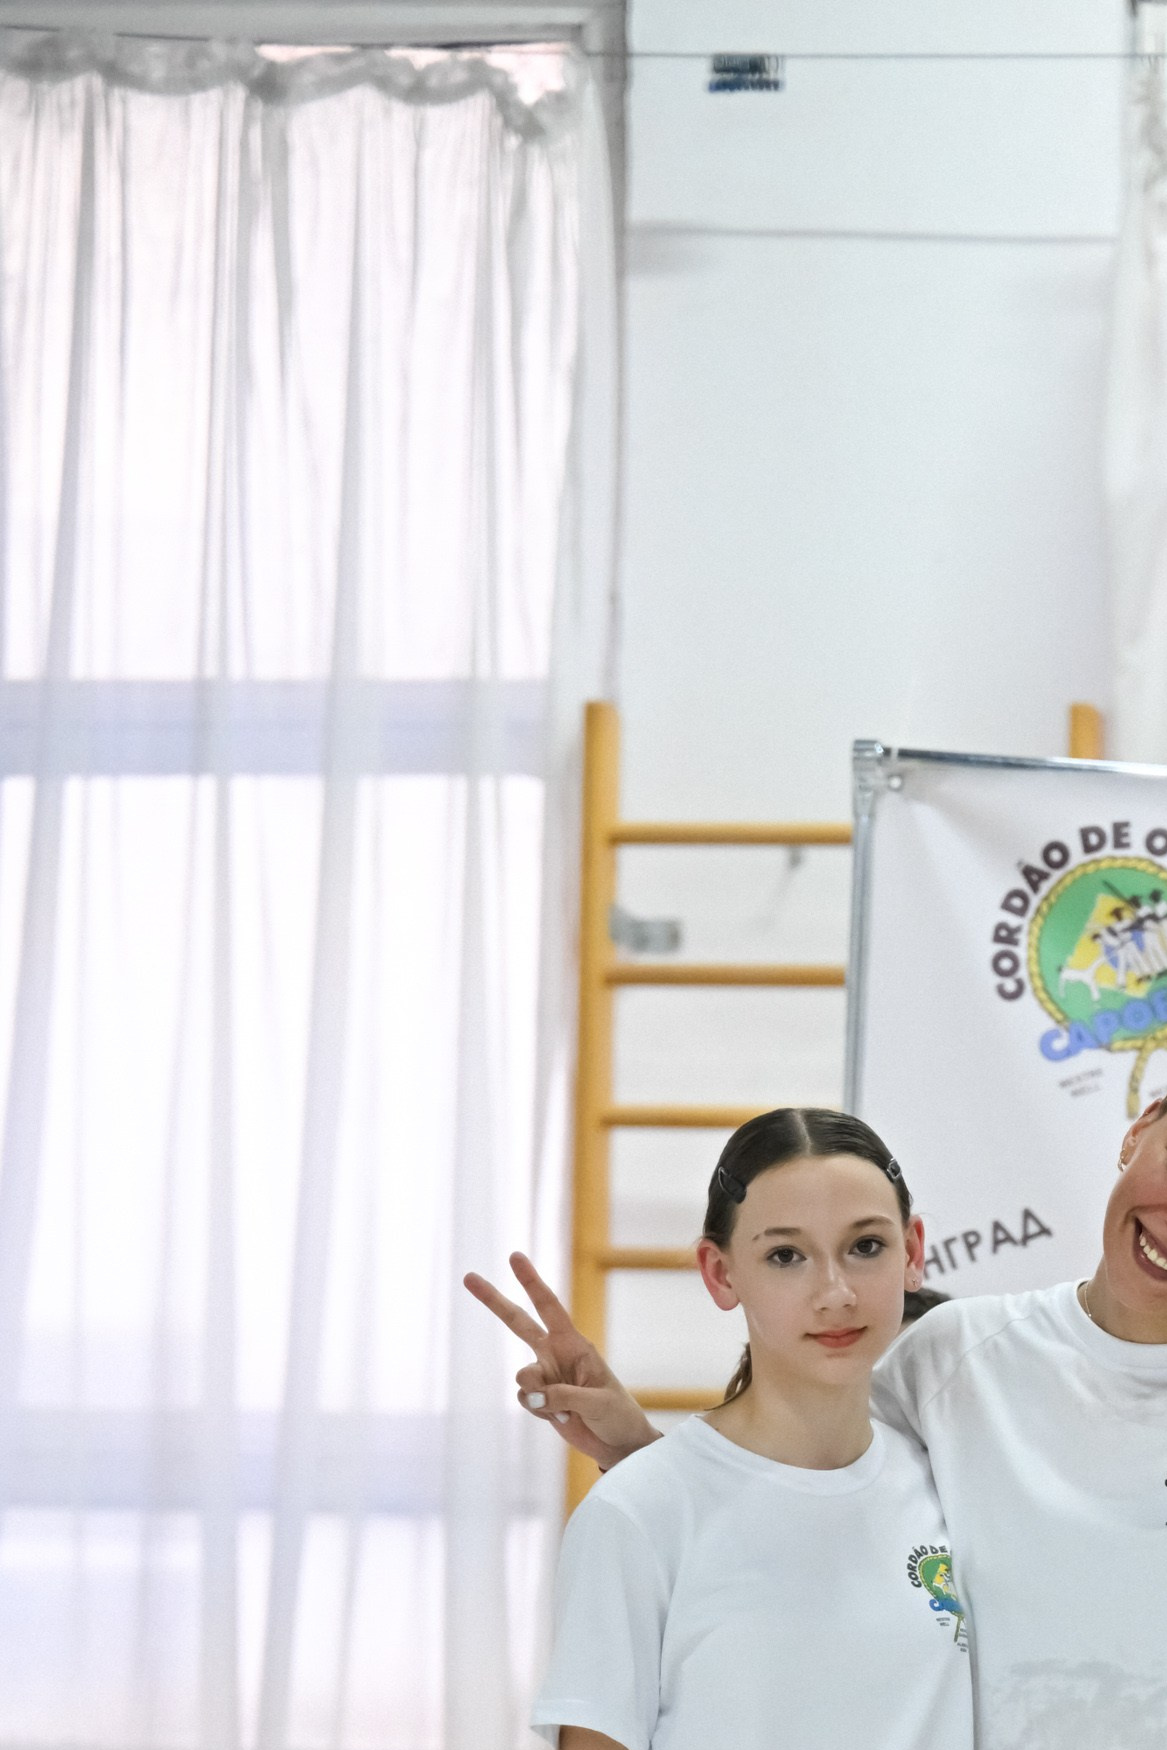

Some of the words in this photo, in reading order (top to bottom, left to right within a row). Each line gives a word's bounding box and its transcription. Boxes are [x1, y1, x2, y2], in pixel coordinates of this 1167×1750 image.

[991, 839, 1070, 1002] CORDÃO
[1080, 821, 1132, 854] DE
[907, 1545, 928, 1588] CORDÃO
